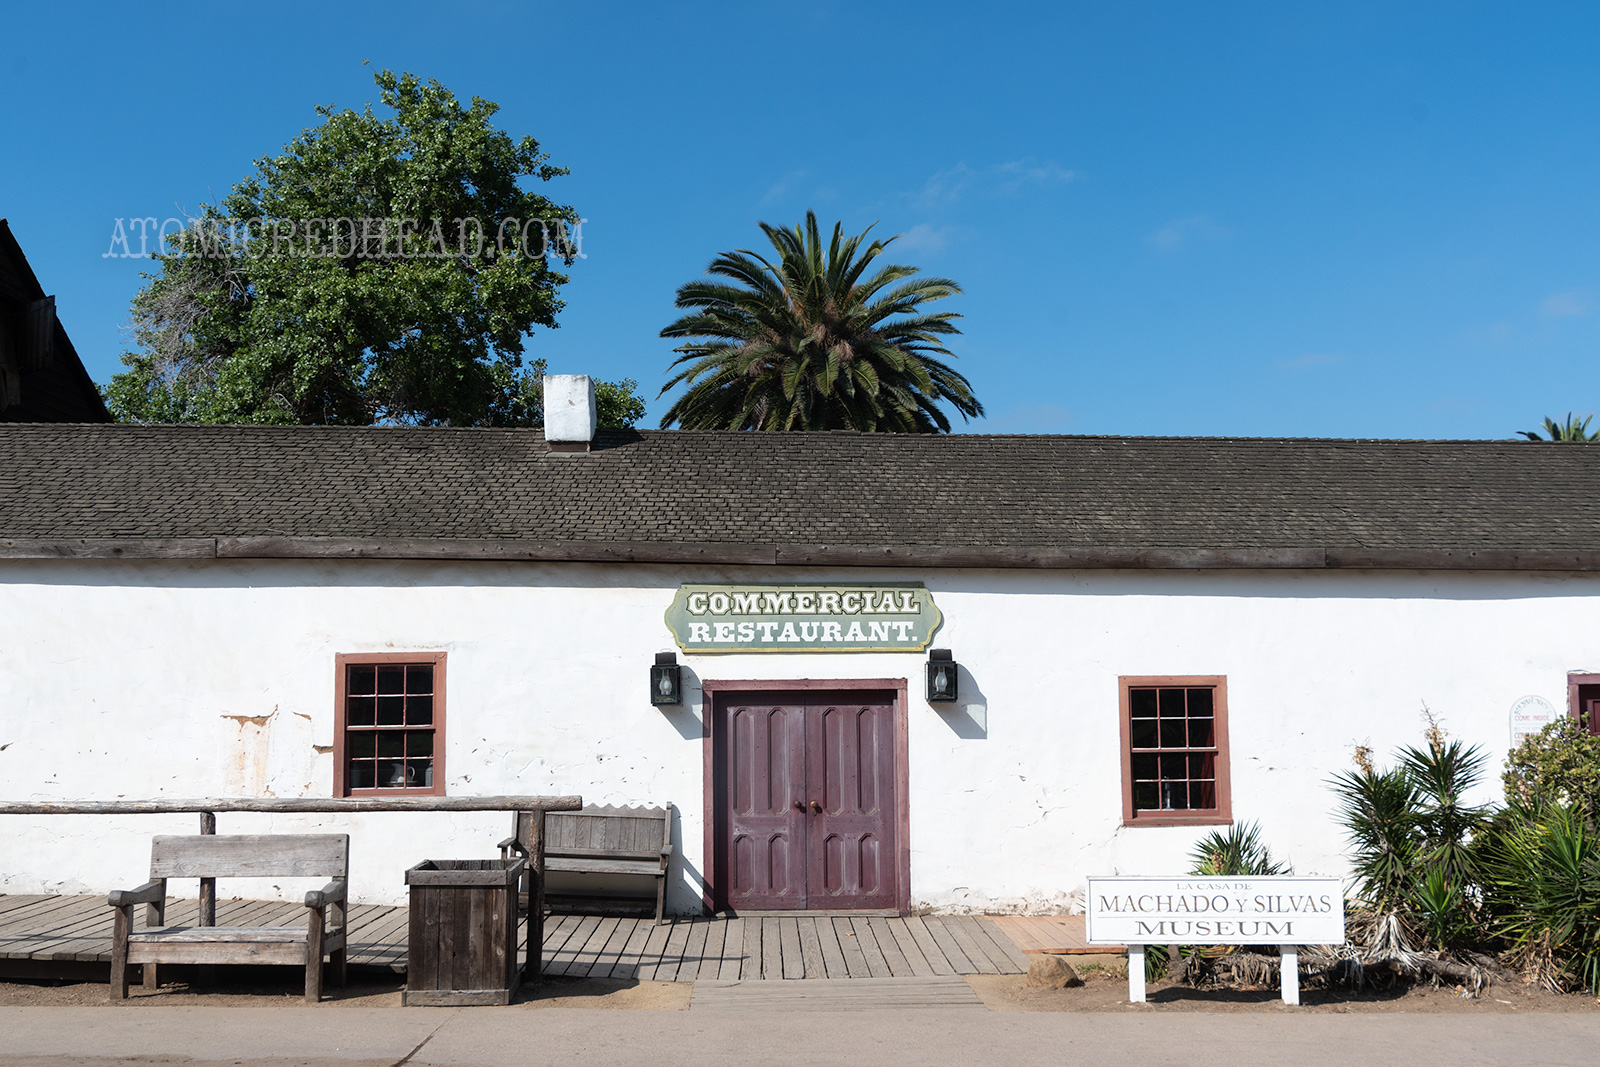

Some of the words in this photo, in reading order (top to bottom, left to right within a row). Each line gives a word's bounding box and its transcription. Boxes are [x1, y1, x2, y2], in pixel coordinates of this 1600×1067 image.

[686, 591, 921, 615] COMMERCIAL
[688, 621, 918, 643] RESTAURANT.
[1099, 895, 1229, 913] MACHADO
[1254, 895, 1332, 913] SILVAS
[1135, 921, 1295, 936] MUSEUM
